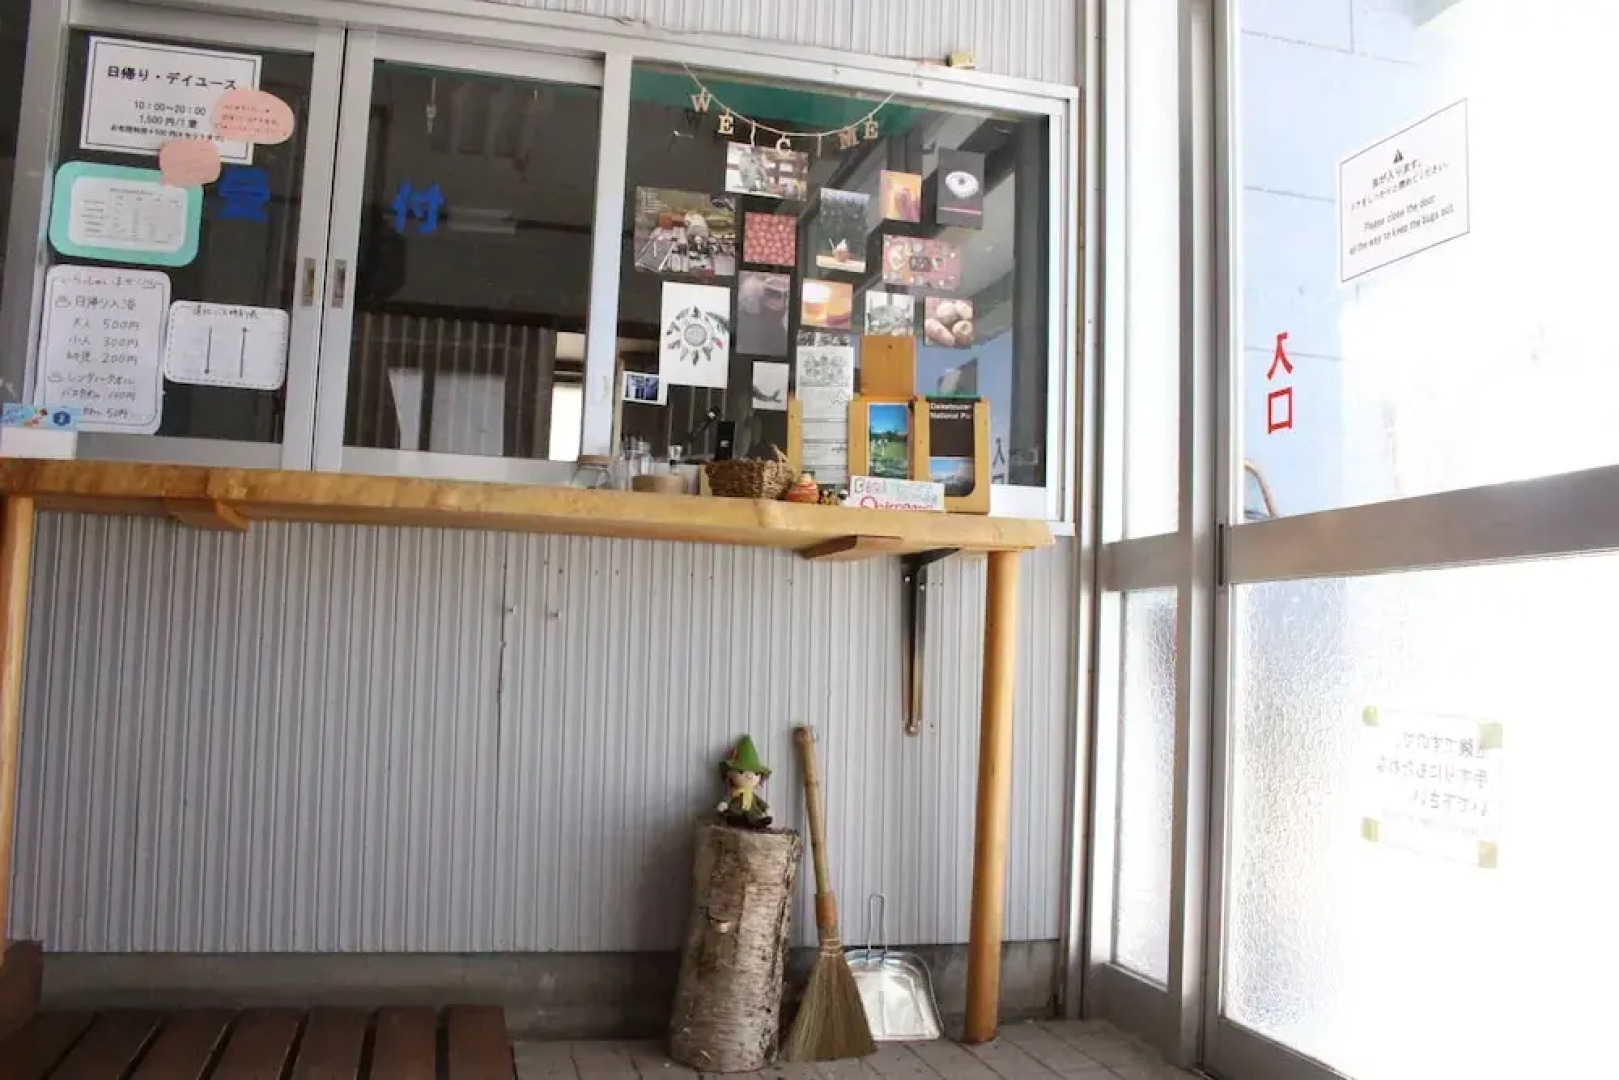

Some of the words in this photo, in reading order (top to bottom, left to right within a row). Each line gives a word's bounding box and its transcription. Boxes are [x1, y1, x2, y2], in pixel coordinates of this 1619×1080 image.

[107, 66, 237, 91] 日帰り・デイユース
[103, 319, 140, 331] 500円
[104, 336, 139, 349] 300円
[101, 353, 138, 366] 200円
